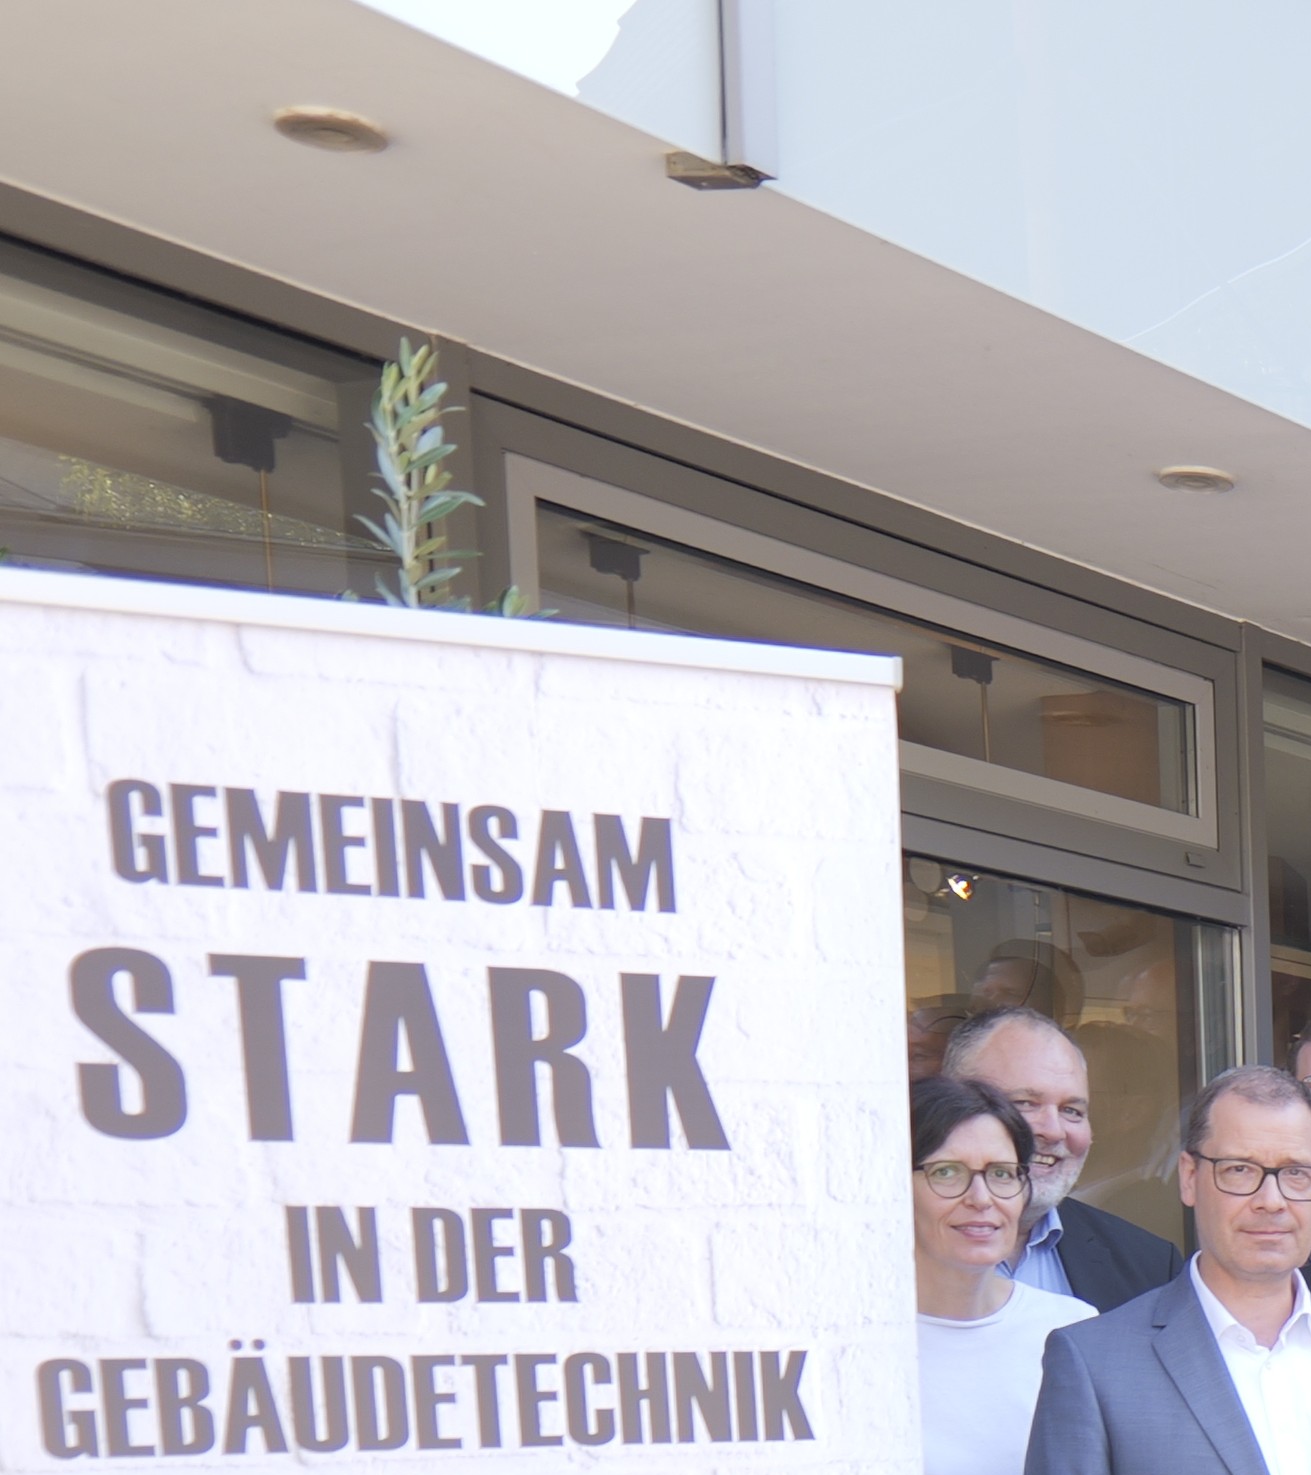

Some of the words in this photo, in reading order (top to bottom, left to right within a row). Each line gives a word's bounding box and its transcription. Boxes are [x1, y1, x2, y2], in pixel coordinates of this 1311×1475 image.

[106, 778, 677, 914] GEMEINSAM
[68, 946, 732, 1151] STARK
[284, 1205, 383, 1304] IN
[412, 1207, 579, 1304] DER
[36, 1339, 816, 1460] GEBÄUDETECHNIK
